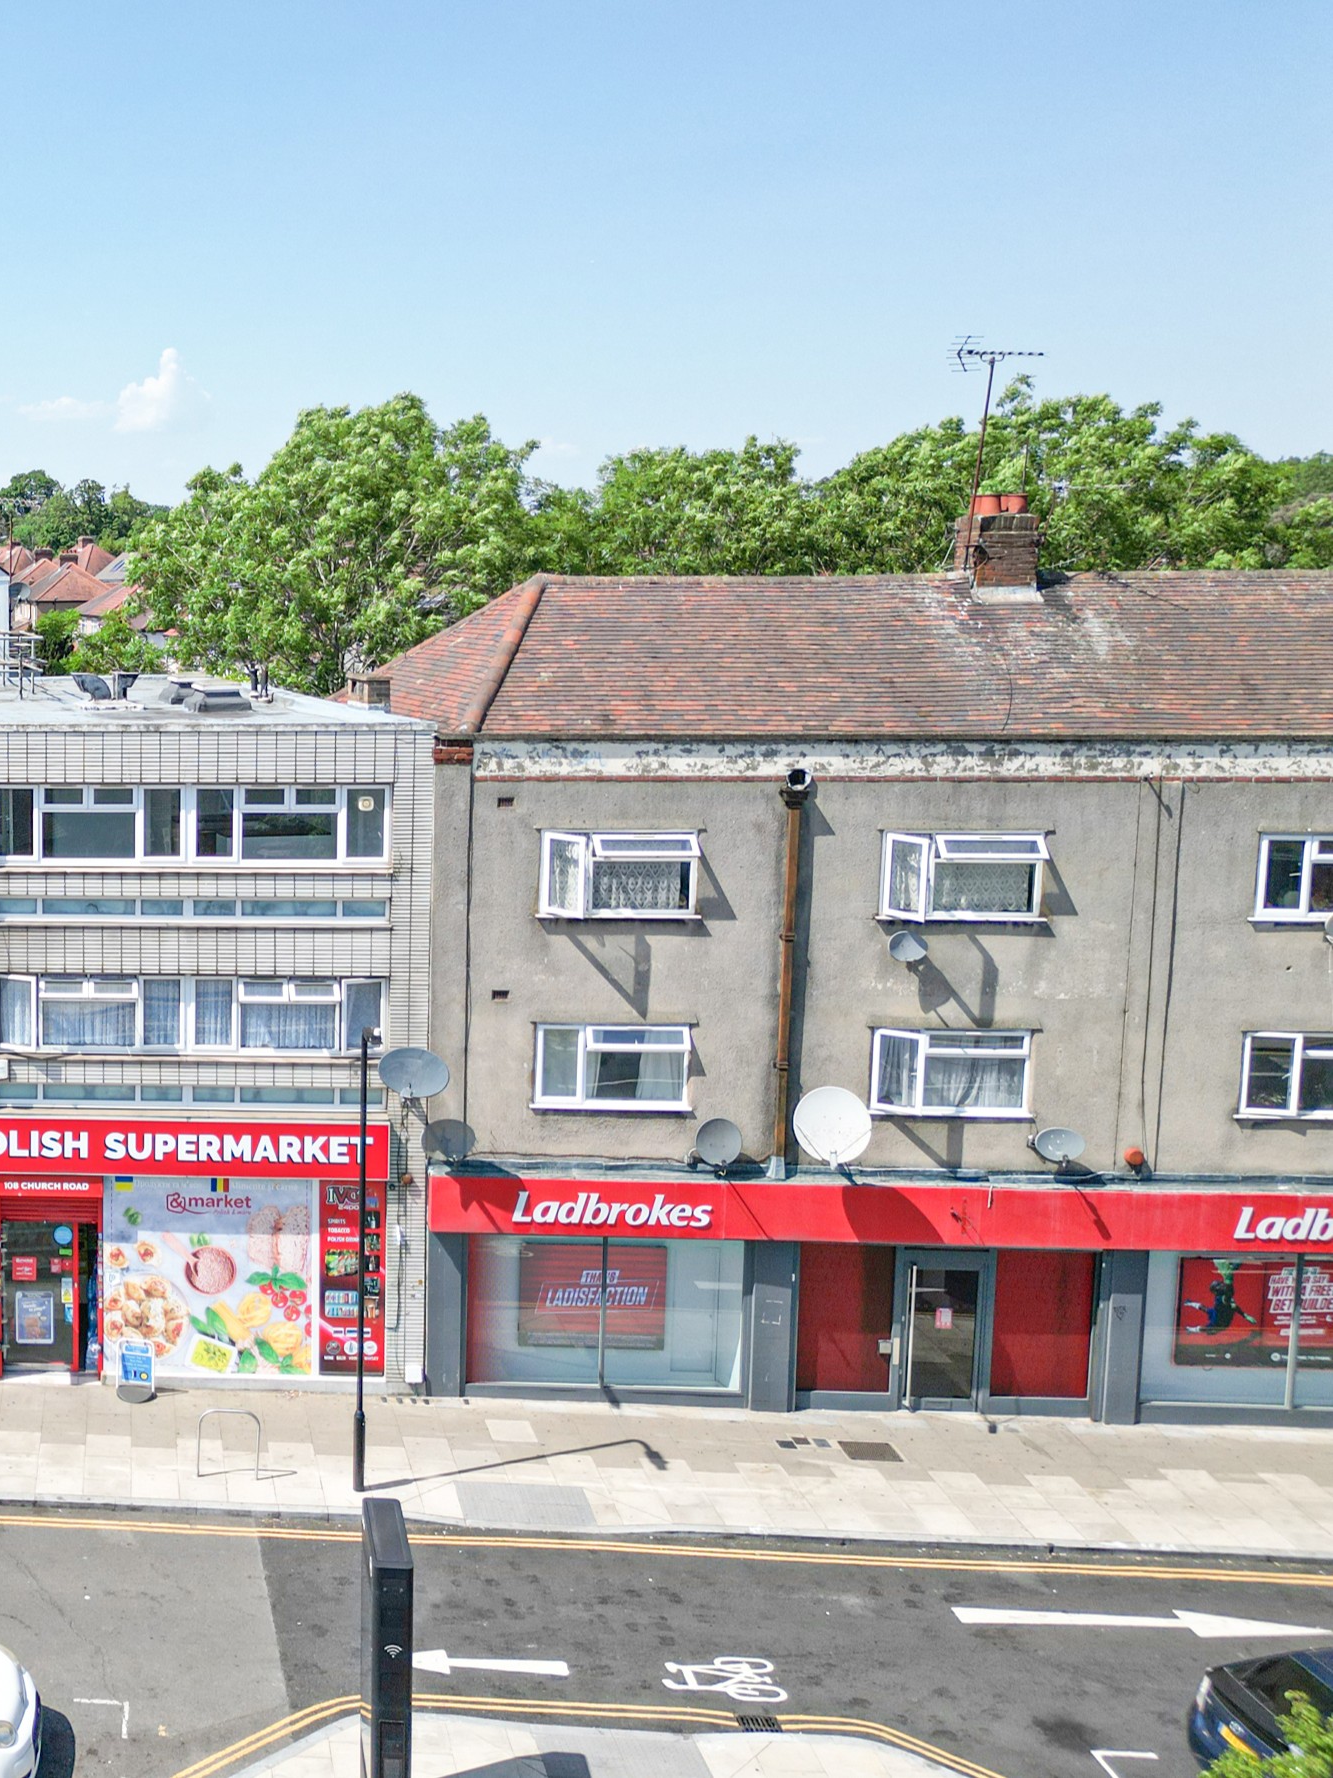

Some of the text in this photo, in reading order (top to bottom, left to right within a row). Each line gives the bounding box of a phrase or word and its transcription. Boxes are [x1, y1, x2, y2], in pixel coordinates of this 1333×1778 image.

[103, 1132, 374, 1165] SUPERMARKET
[21, 1182, 61, 1190] CHURCH
[63, 1182, 90, 1191] ROAD
[511, 1190, 713, 1228] Ladbrokes
[546, 1286, 649, 1307] LADISFACTION
